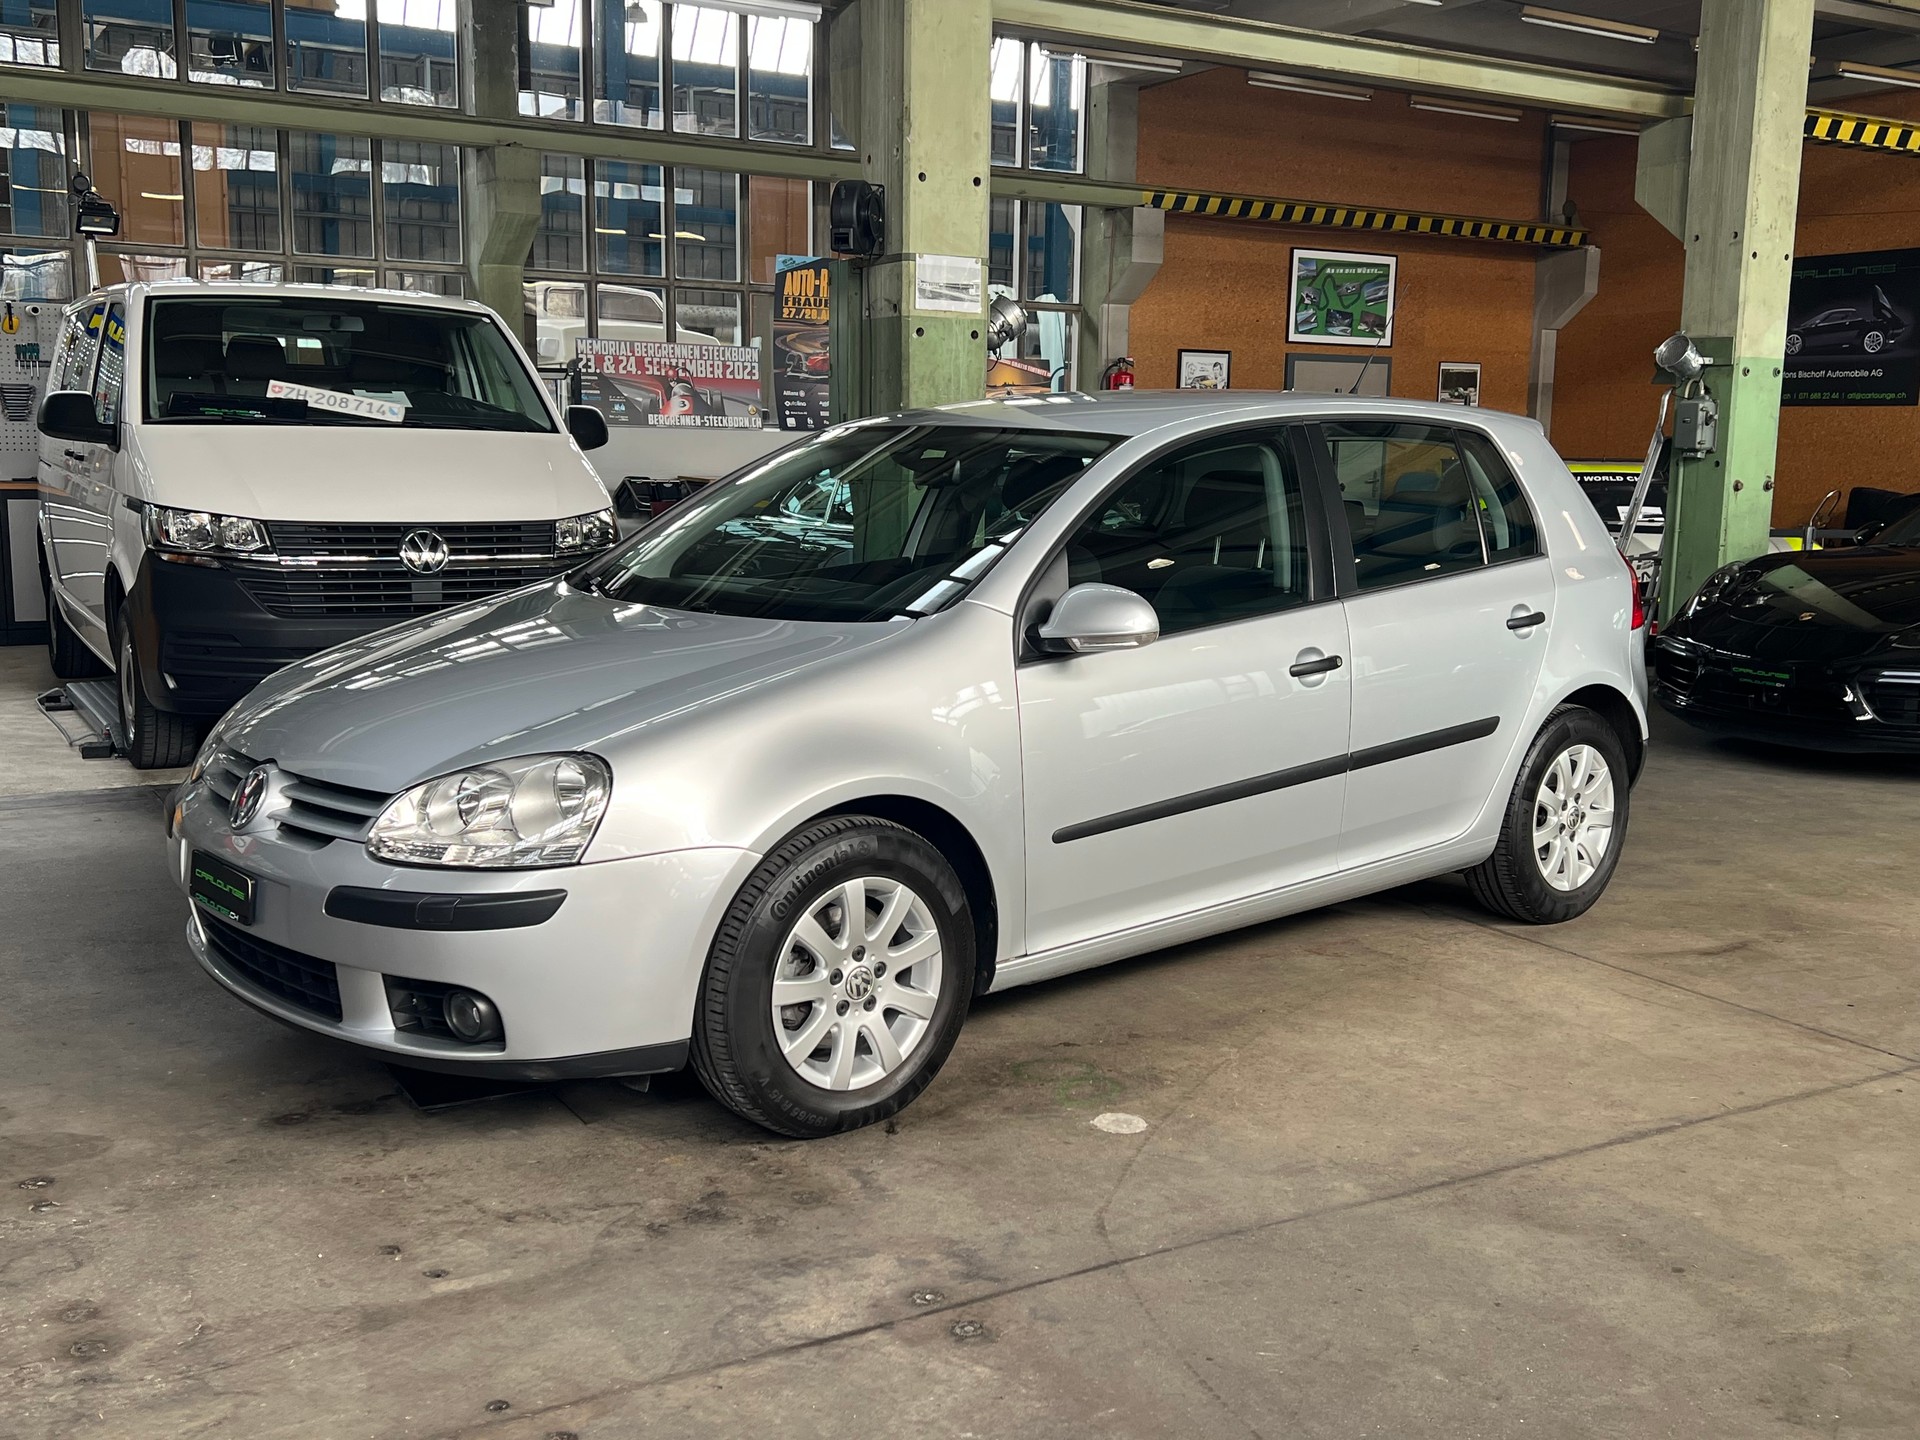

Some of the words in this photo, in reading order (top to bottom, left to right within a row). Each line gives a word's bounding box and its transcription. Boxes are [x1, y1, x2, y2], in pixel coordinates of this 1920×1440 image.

[783, 268, 829, 298] AUTO-R
[1793, 264, 1897, 279] ARLOUNGE
[577, 339, 633, 356] MEMORIAL
[634, 342, 700, 360] BERGRENNEN
[702, 345, 759, 362] STECKBORN
[577, 353, 600, 374] 23.
[603, 355, 616, 374] &
[618, 356, 642, 375] 24.
[644, 358, 723, 379] SEPTEMBER
[725, 361, 760, 380] 2023
[1798, 369, 1826, 379] Bischoff
[1826, 369, 1869, 378] Automobile
[1870, 368, 1884, 377] AG
[648, 413, 762, 429] BERGRENNEN-STECKBORN.CH
[770, 841, 855, 921] Continental
